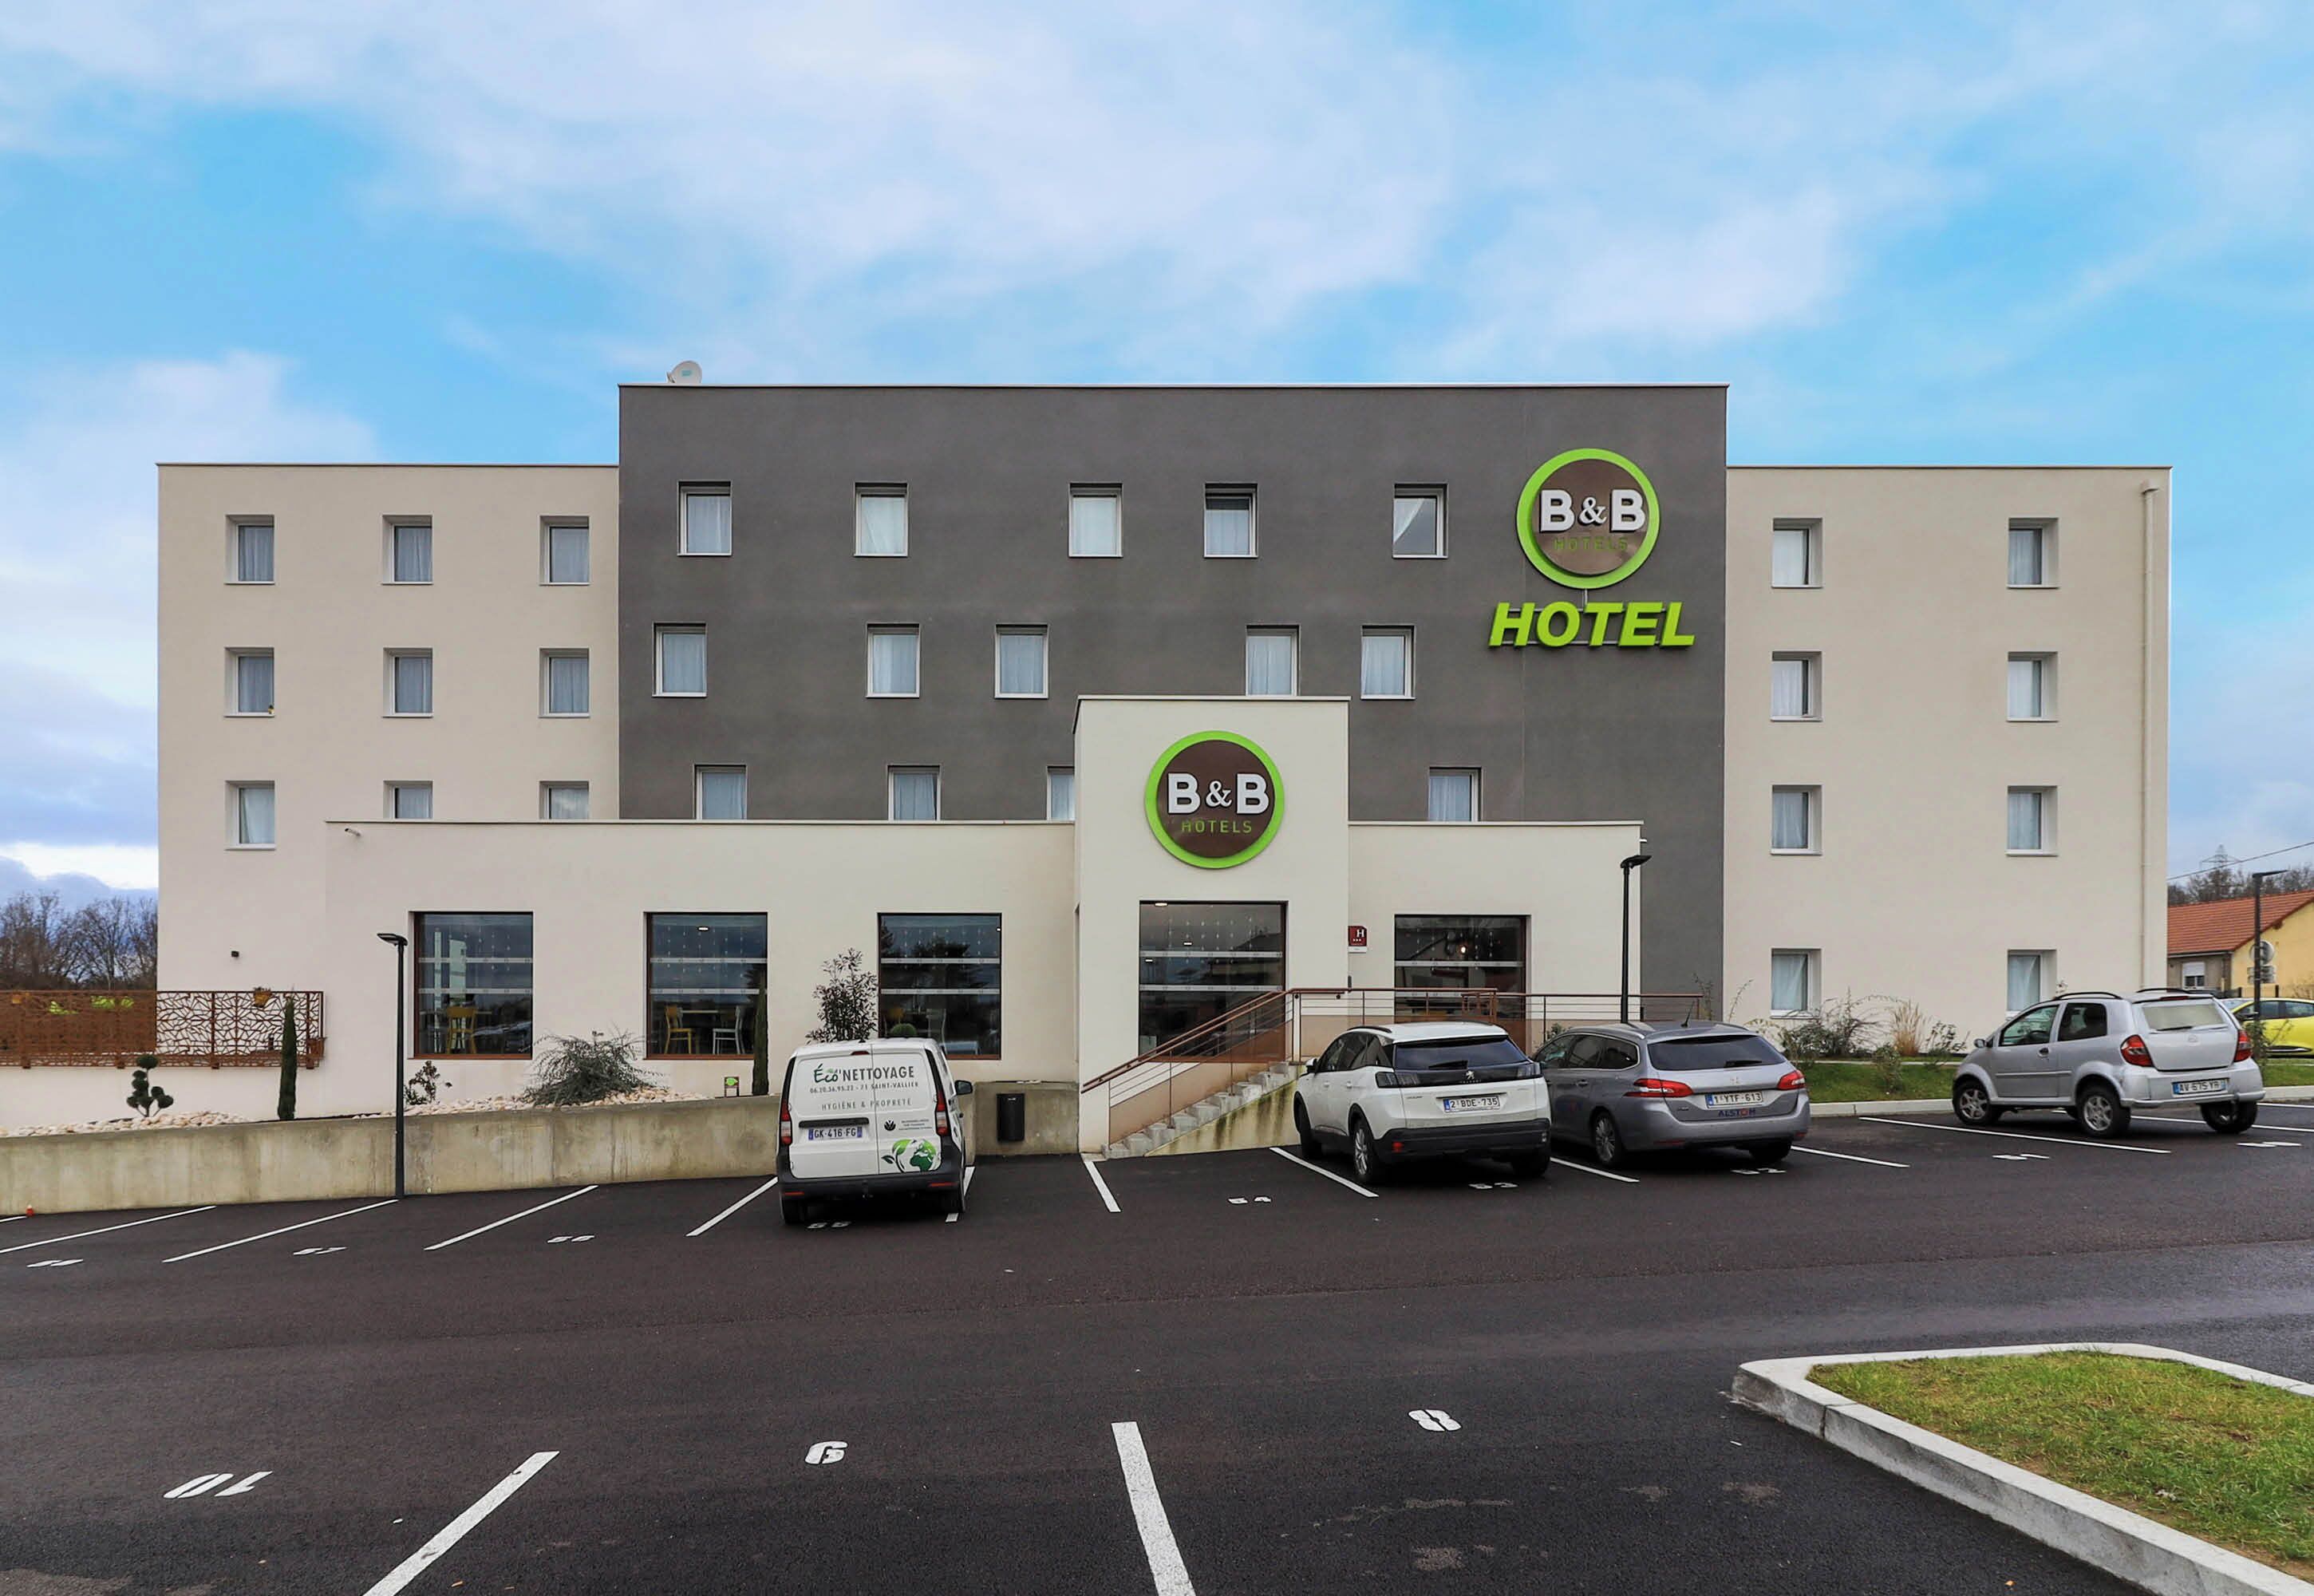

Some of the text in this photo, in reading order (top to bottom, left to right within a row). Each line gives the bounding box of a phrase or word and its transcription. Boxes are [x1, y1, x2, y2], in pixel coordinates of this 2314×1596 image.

[1540, 488, 1647, 533] B&B
[1554, 535, 1629, 552] HOTELS
[1488, 601, 1696, 647] HOTEL
[1167, 772, 1270, 814] B&B
[1181, 820, 1252, 834] HOTELS
[1356, 929, 1364, 938] H
